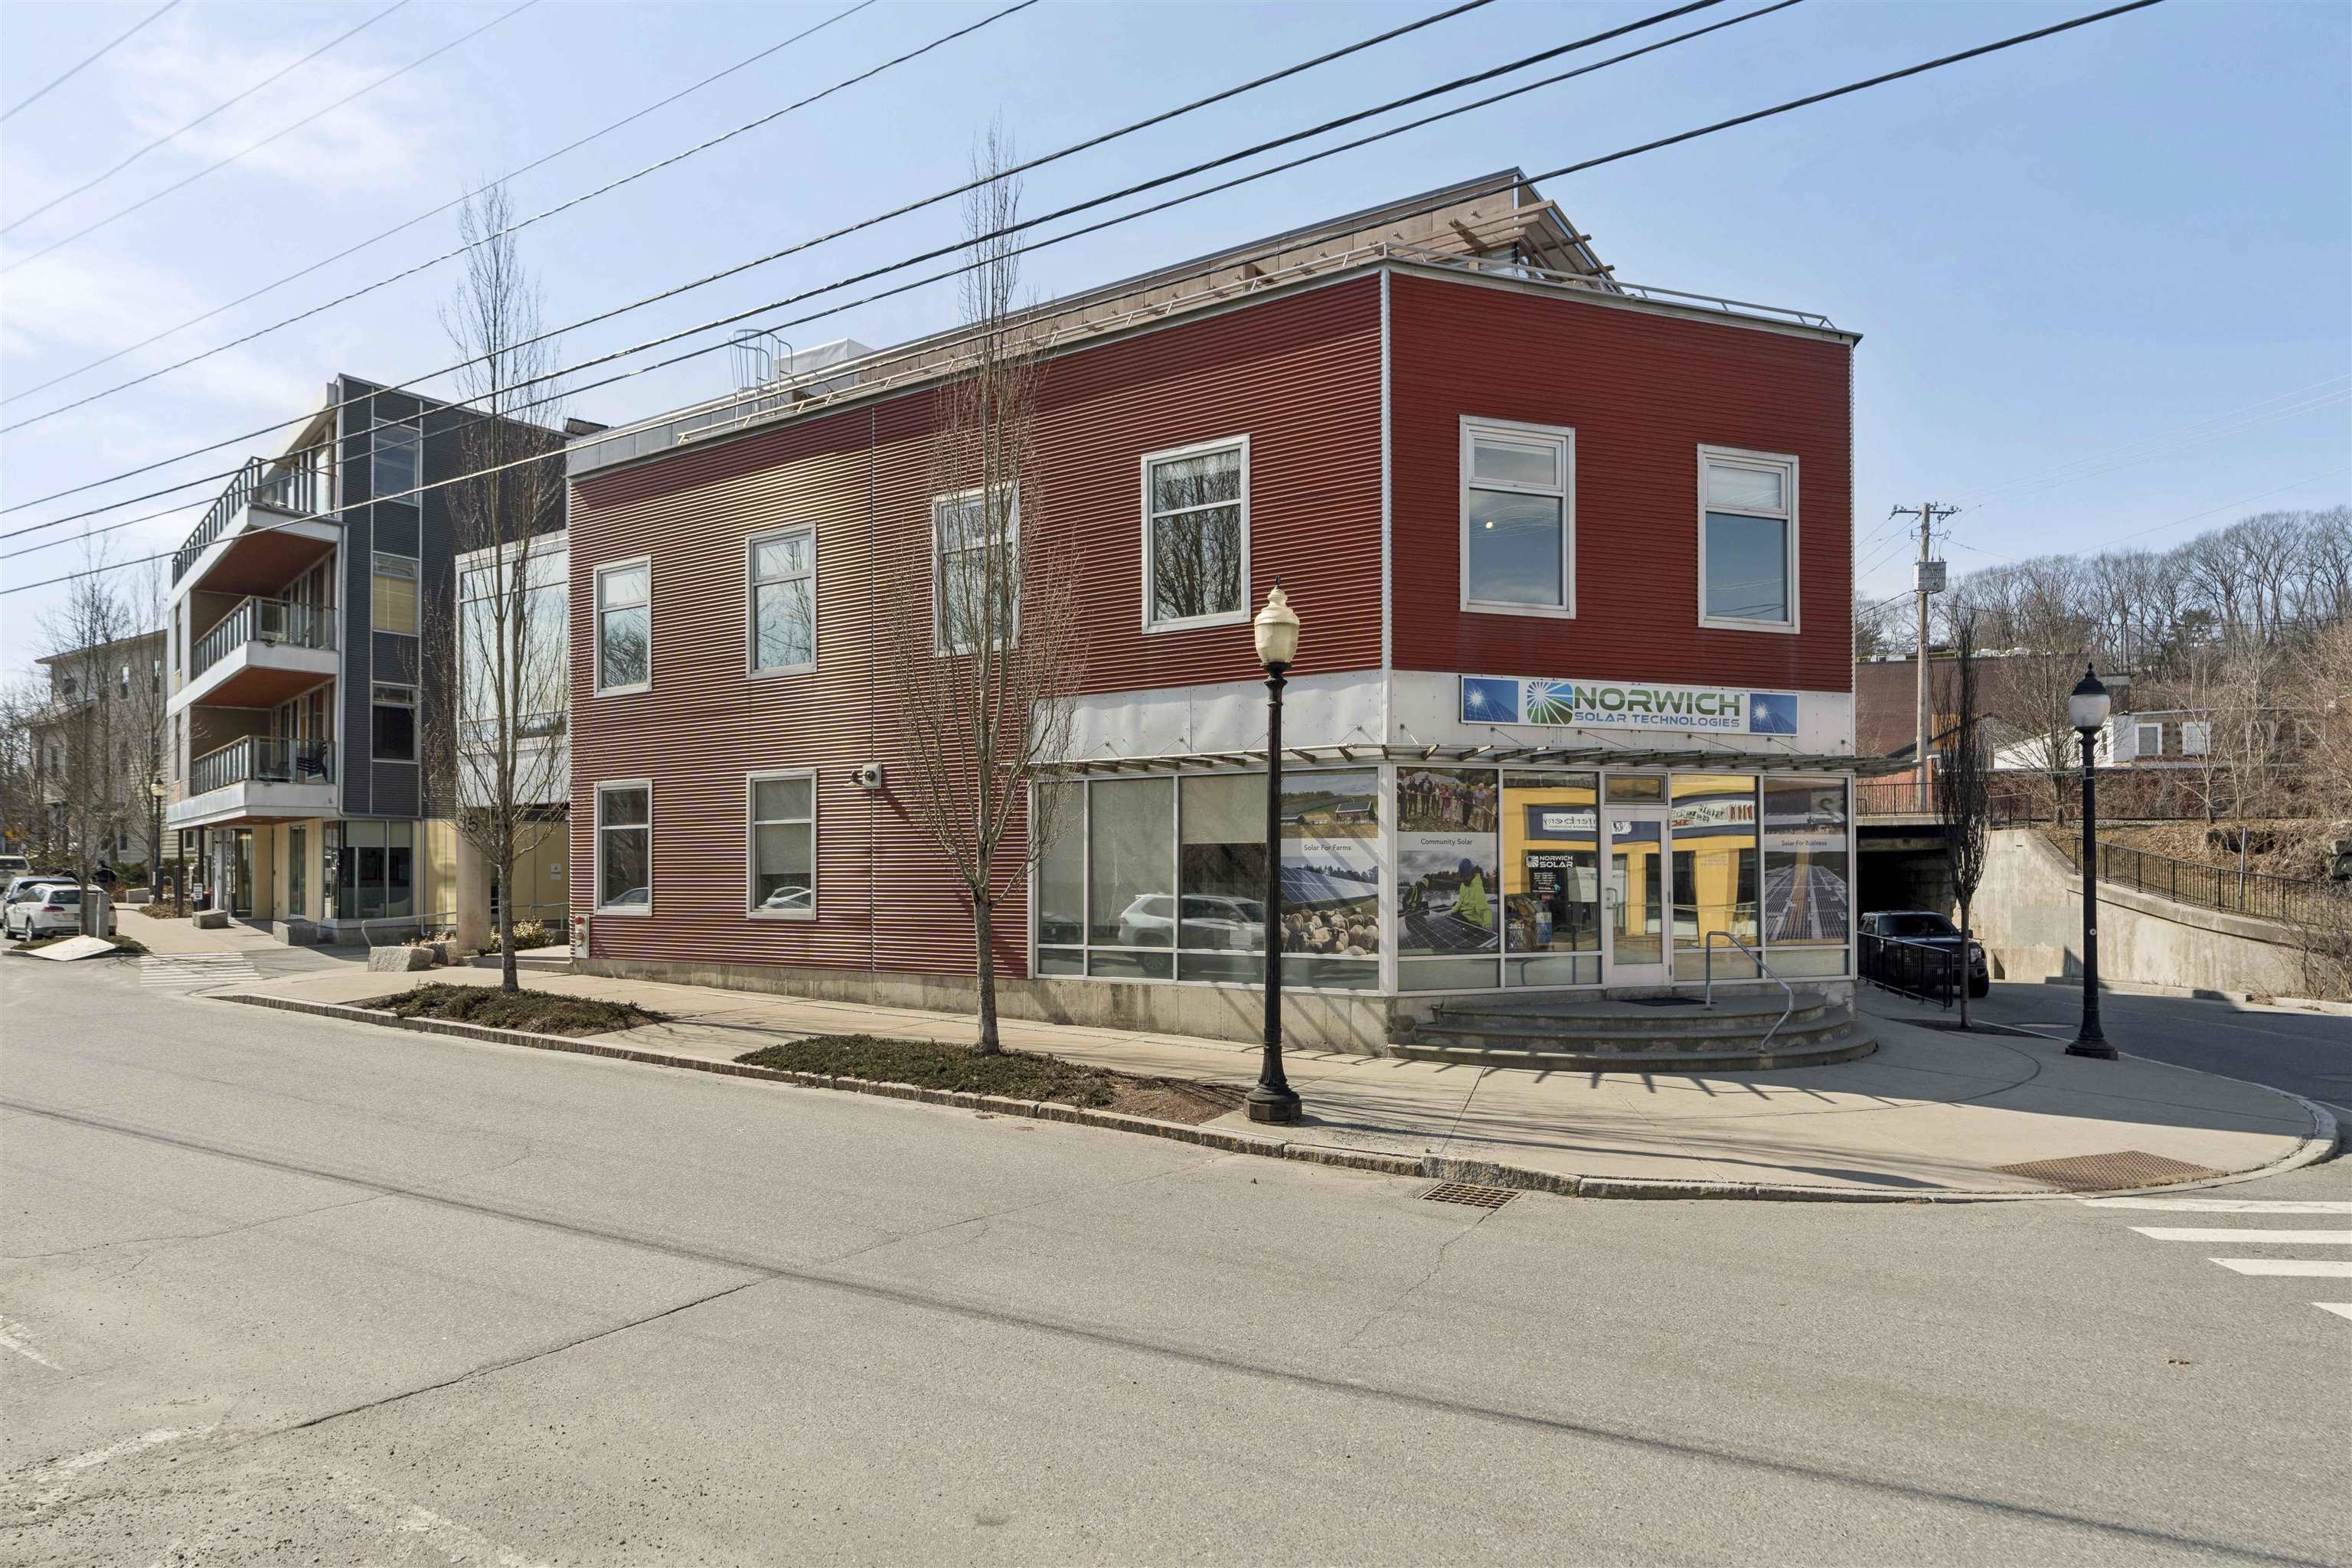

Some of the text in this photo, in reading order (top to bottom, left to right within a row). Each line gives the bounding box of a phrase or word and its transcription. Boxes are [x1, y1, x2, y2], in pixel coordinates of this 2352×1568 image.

[1574, 686, 1740, 716] NORWICH
[1574, 712, 1740, 727] SOLAR TECHNOLOGIES
[1420, 838, 1455, 847] Community
